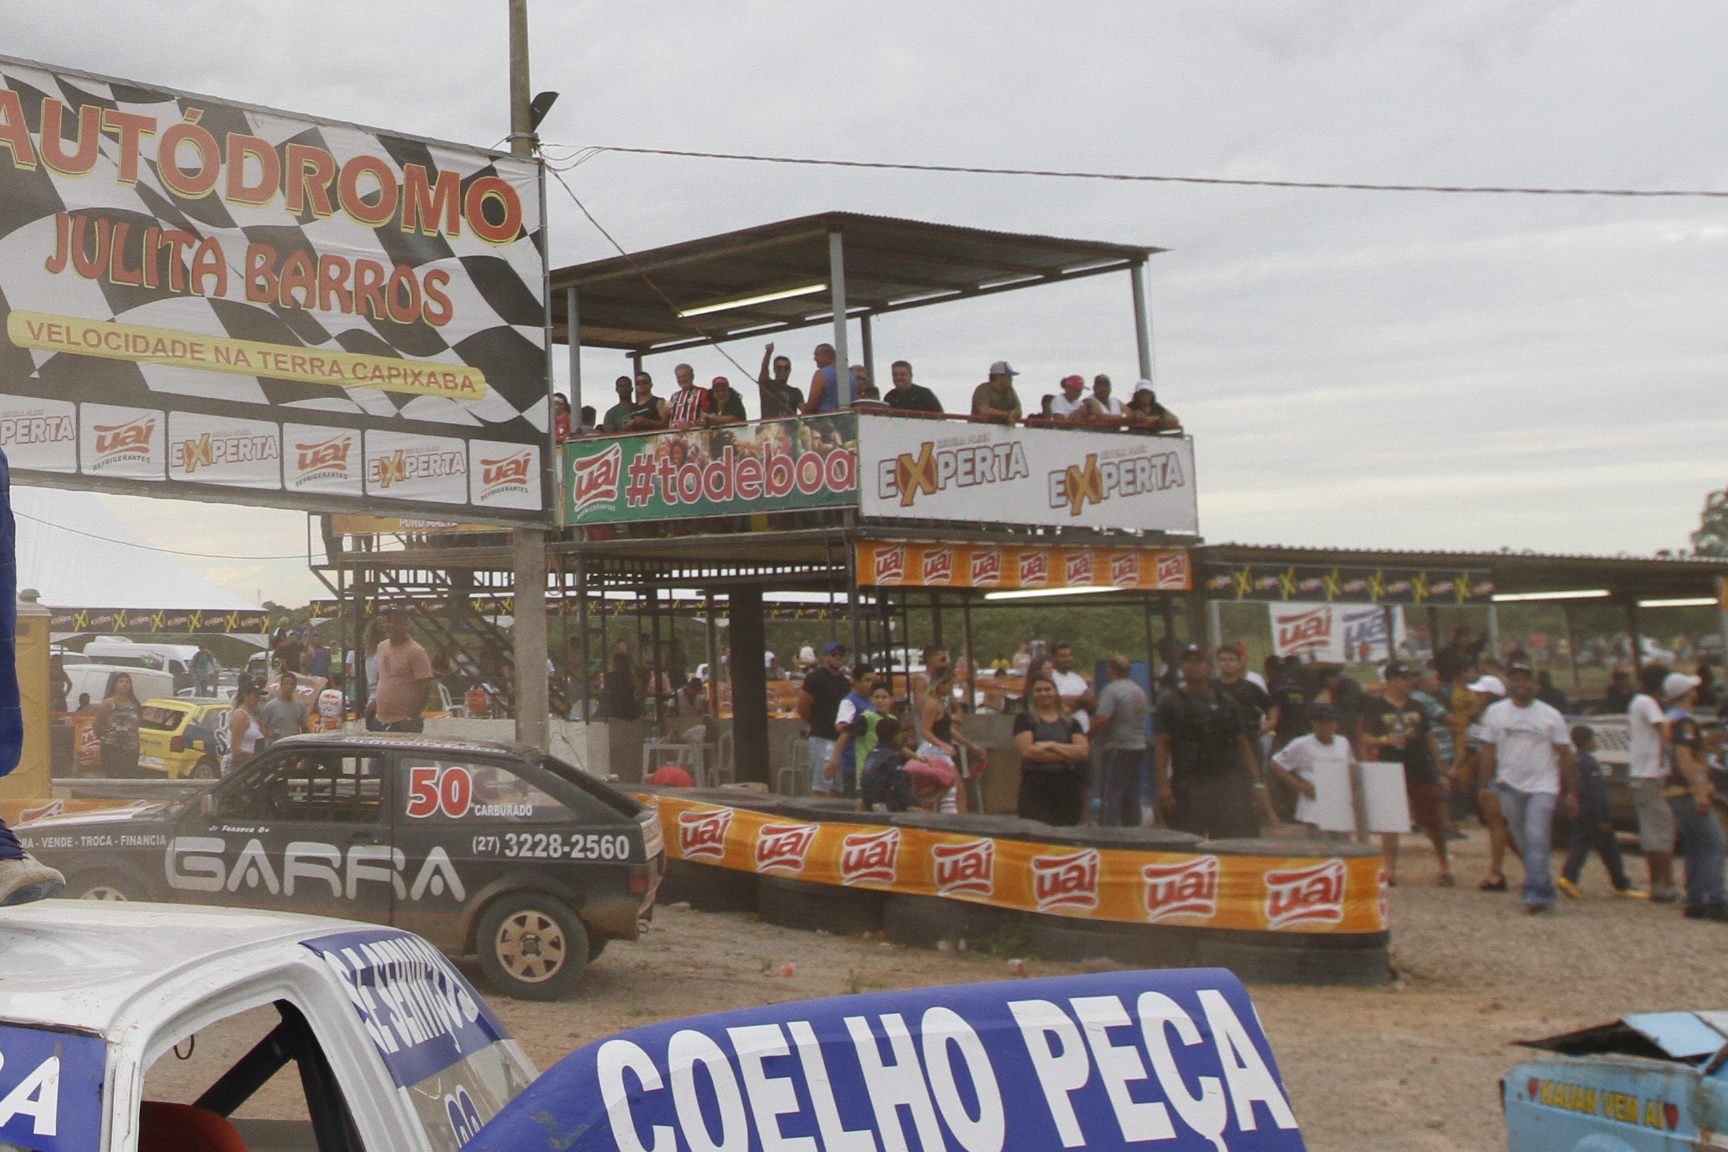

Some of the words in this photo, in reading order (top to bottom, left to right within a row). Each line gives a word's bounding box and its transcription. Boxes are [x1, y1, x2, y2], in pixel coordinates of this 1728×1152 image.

[45, 212, 227, 298] JULITA
[245, 243, 454, 328] BARROS
[26, 320, 206, 362] VELOCIDADE
[214, 345, 252, 368] NA
[257, 350, 346, 379] TERRA
[351, 361, 477, 394] CAPIXABA
[92, 454, 151, 471] REFRIGERANTES
[172, 434, 279, 473] EXPERTA
[368, 450, 467, 488] EXPERTA
[295, 472, 348, 487] REFRIGERANTES
[480, 486, 529, 502] REFRIGERANTES
[626, 443, 858, 508] #todeboa
[878, 442, 1030, 507] EXPERTA
[1048, 452, 1186, 516] EXPERTA
[405, 766, 472, 819] 50
[474, 804, 532, 817] CARBURADO
[42, 836, 72, 847] VENDE
[81, 835, 112, 847] TROCA
[121, 834, 167, 846] FINANCIA
[221, 824, 255, 833] Fonseca
[472, 835, 500, 855] (27)
[504, 833, 630, 859] 3228-2560
[596, 1006, 1005, 1152] COELHO
[1007, 989, 1300, 1152] PEÇA
[1539, 1079, 1599, 1115] KAUAN
[1601, 1090, 1640, 1125] VEM
